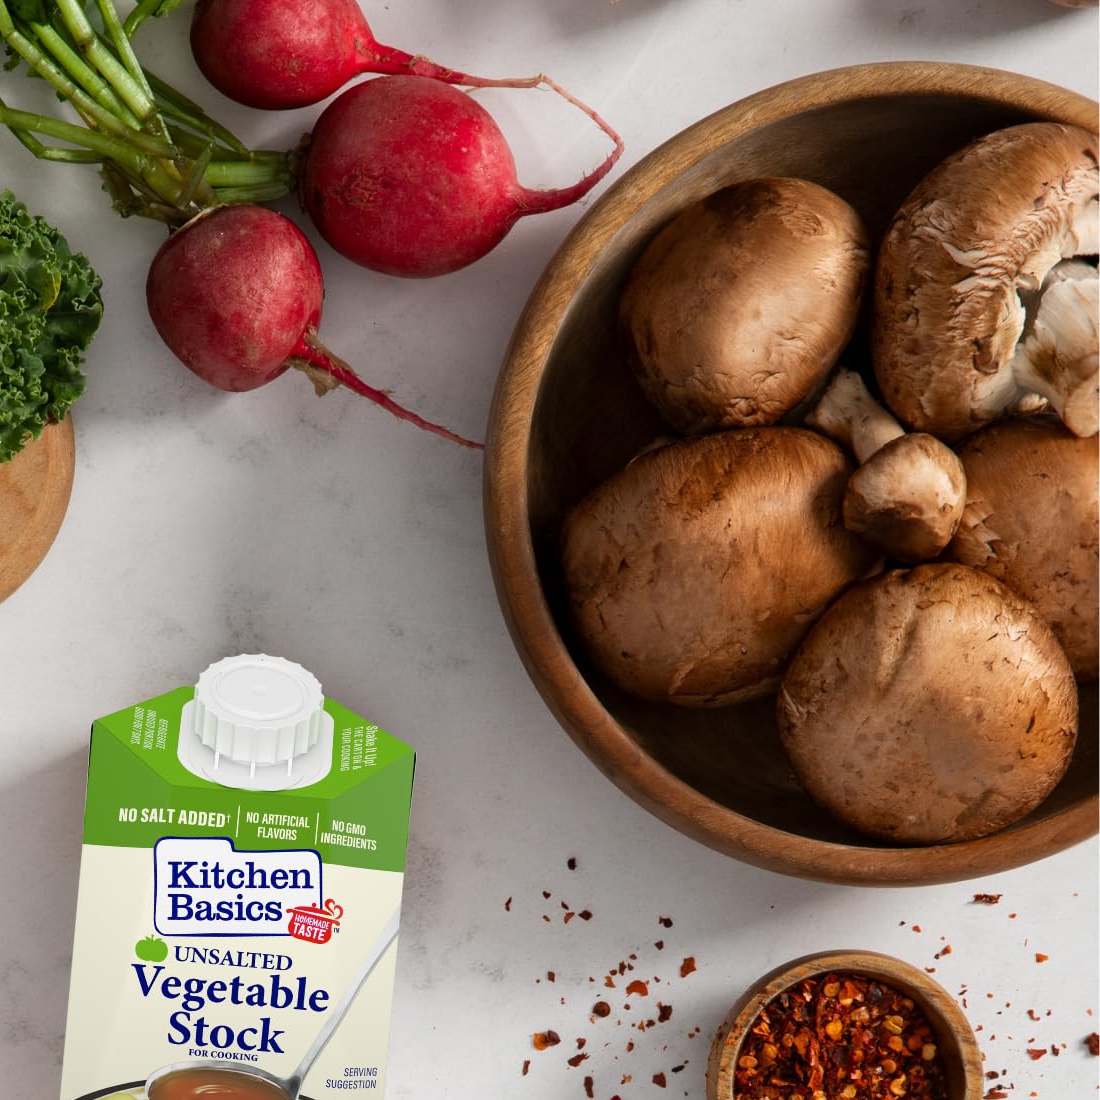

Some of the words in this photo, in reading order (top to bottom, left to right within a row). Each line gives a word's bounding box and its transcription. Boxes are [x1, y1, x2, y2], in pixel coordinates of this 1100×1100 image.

[342, 728, 351, 744] YOUR
[354, 726, 363, 738] THE
[366, 726, 378, 746] Shake
[340, 745, 350, 771] COOKING
[353, 739, 362, 764] CARTON
[362, 754, 377, 766] Up!
[119, 808, 137, 822] NO
[141, 808, 174, 824] SALT
[246, 812, 260, 823] NO
[262, 814, 310, 828] ARTIFICIAL
[258, 826, 297, 841] FLAVORS
[332, 820, 344, 831] NO
[346, 823, 366, 835] GMO
[320, 832, 377, 850] INGREDIENTS
[168, 861, 313, 889] Kitchen
[168, 894, 282, 922] Basics
[295, 914, 329, 929] HOMEMADE
[294, 922, 326, 940] TASTE
[174, 945, 293, 971] UNSALTED
[131, 963, 330, 1012] Vegetable
[167, 1012, 285, 1054] Stock
[188, 1049, 208, 1058] FOR
[210, 1050, 258, 1062] COOKING
[344, 1067, 377, 1077] SERVING
[326, 1079, 377, 1090] SUGGESTION
